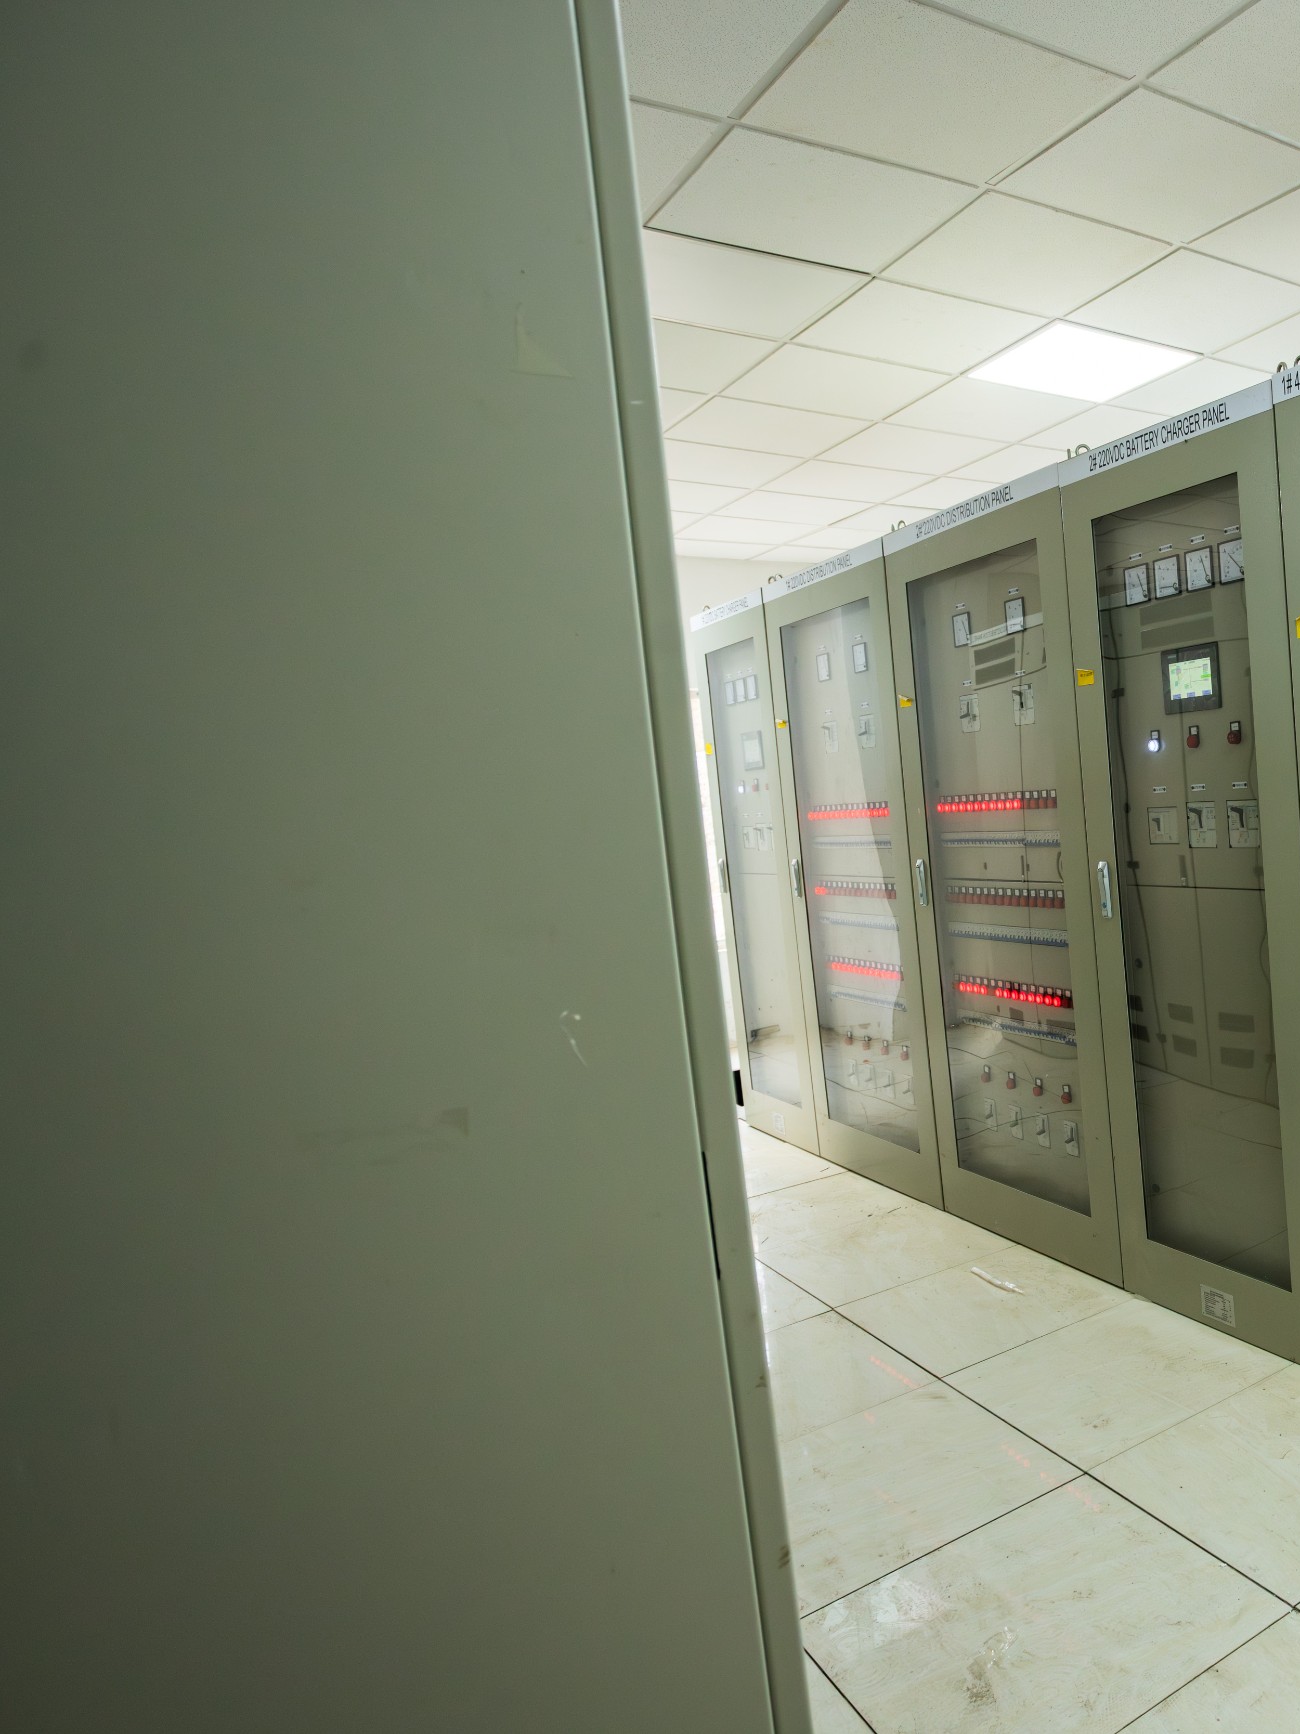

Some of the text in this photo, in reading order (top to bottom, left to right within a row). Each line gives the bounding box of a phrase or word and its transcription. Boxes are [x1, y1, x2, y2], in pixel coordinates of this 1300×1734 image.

[1281, 371, 1292, 396] 1#
[1088, 402, 1230, 472] 2# 220VDC BATTERY CHARGER PANEL
[946, 494, 991, 526] DISTRIBUTION
[991, 485, 1014, 507] PANEL
